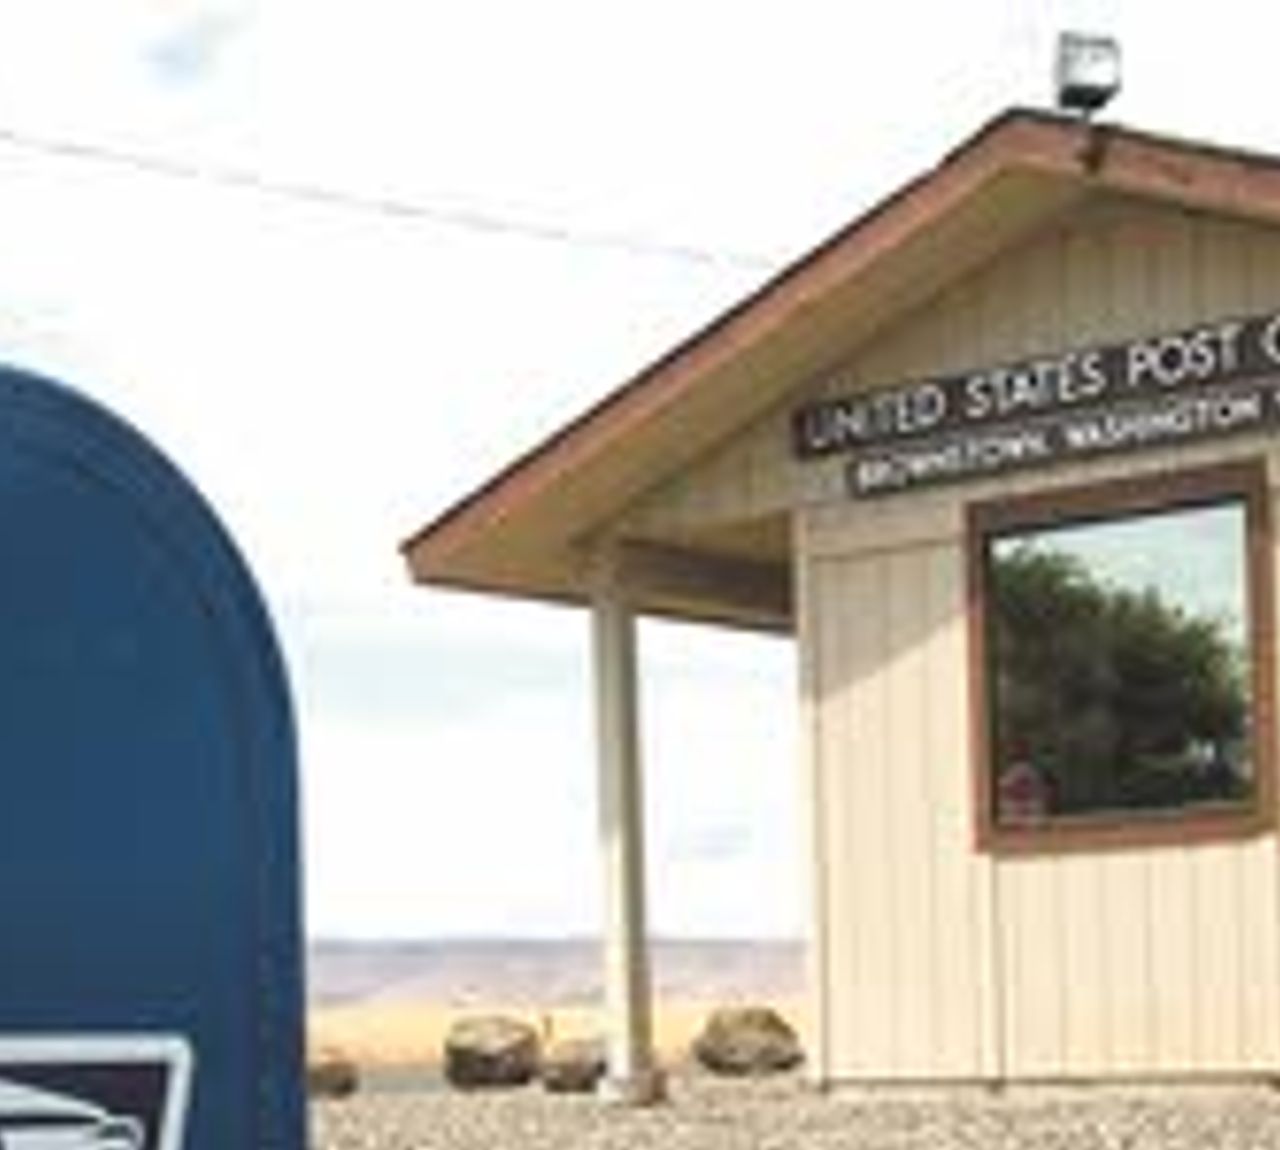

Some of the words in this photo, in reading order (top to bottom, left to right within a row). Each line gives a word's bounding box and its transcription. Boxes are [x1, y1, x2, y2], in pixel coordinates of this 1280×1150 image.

[804, 382, 946, 446] UNITED
[964, 350, 1108, 418] STATES
[1127, 326, 1242, 388] POST
